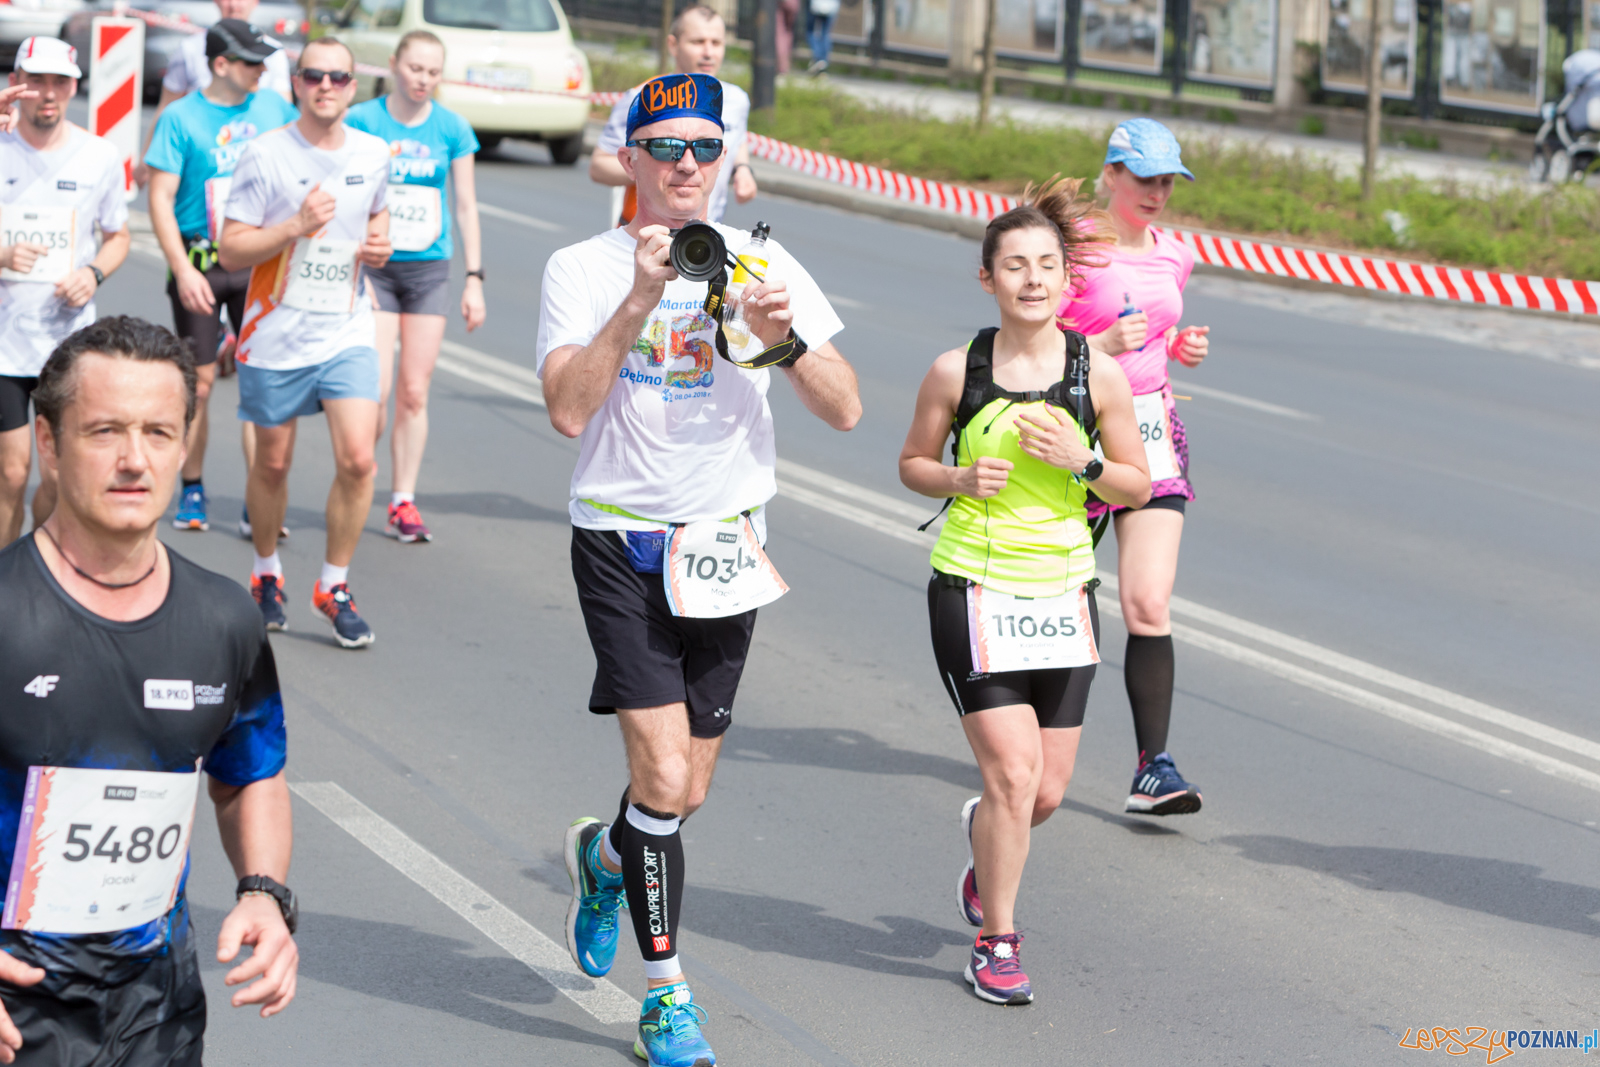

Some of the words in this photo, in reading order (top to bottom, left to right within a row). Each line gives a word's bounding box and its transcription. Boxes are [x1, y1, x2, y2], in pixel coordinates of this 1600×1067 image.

[387, 203, 427, 223] 422
[300, 260, 350, 281] 3505
[619, 367, 662, 386] Dębno
[674, 391, 707, 400] 08.04.2018
[992, 614, 1077, 638] 11065
[23, 674, 60, 698] 4F
[167, 689, 189, 700] PKO
[62, 823, 181, 864] 5480
[102, 874, 137, 887] jacek
